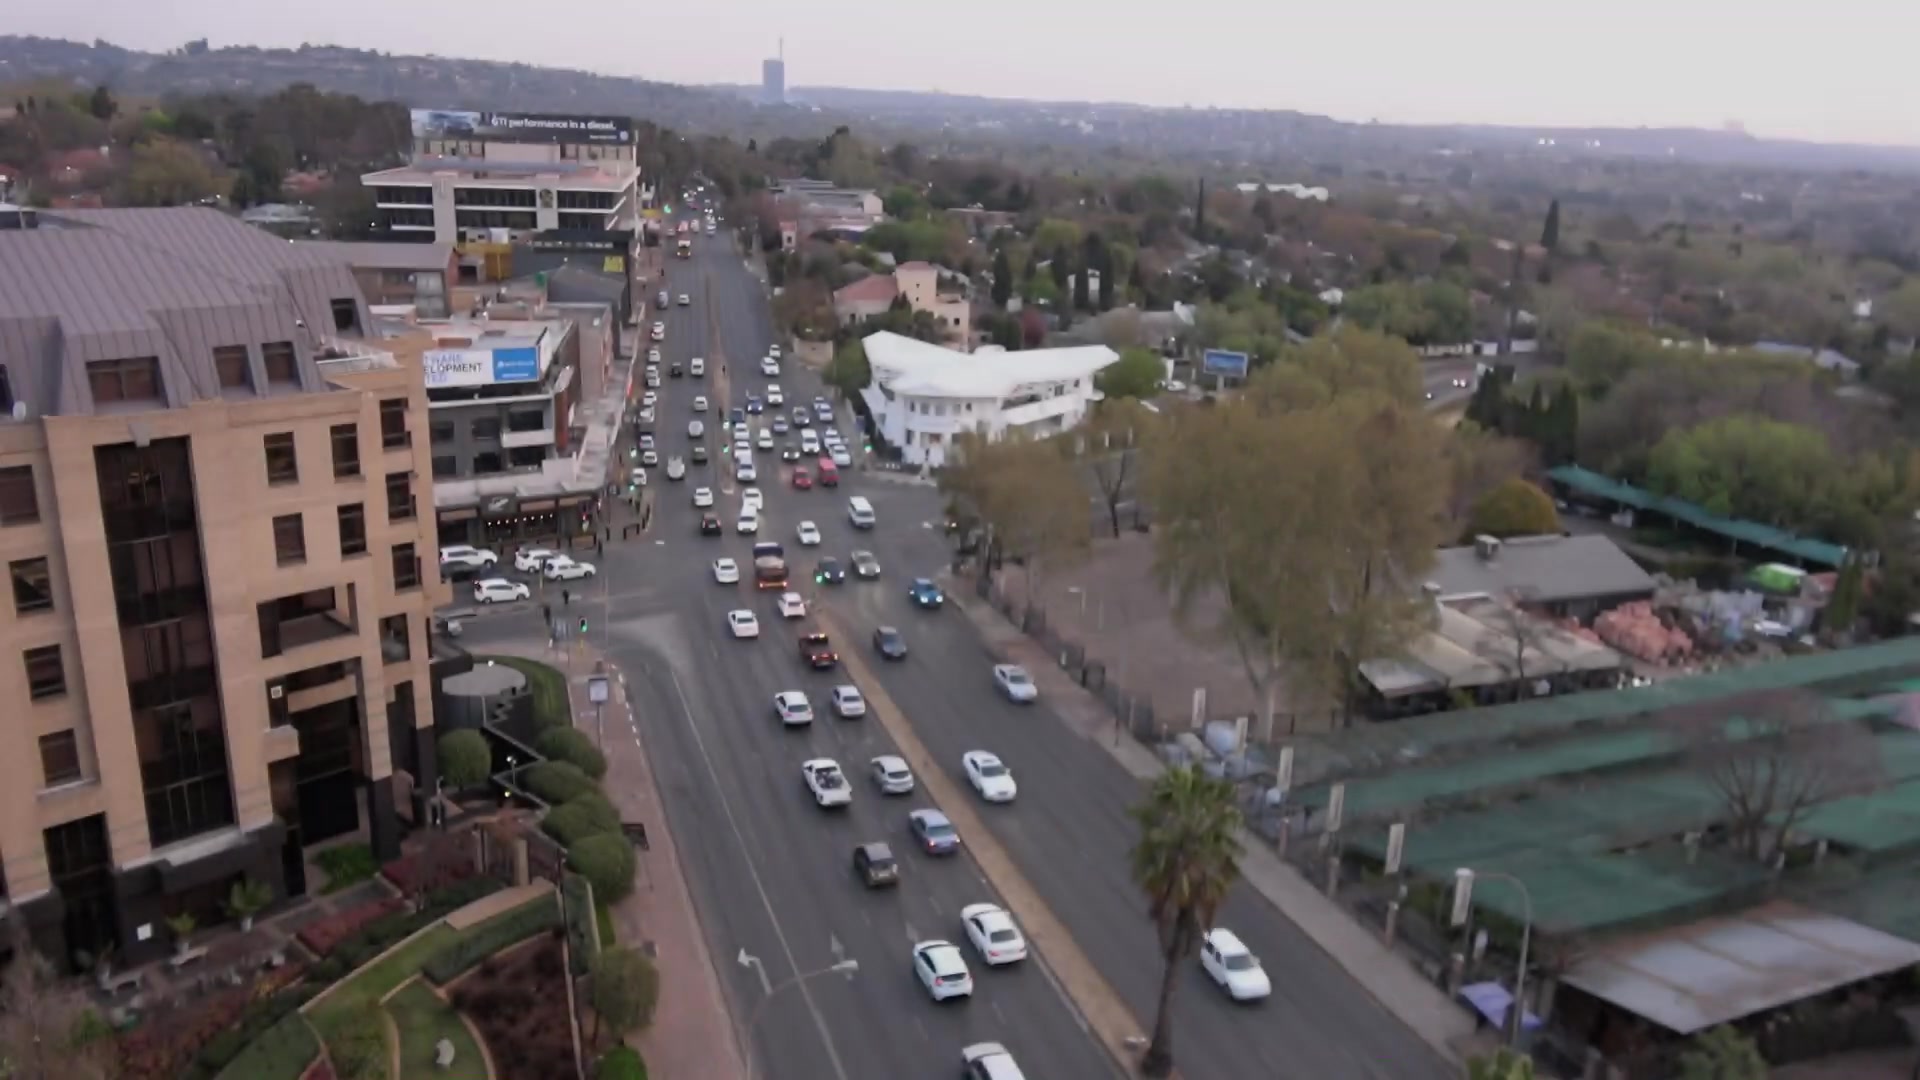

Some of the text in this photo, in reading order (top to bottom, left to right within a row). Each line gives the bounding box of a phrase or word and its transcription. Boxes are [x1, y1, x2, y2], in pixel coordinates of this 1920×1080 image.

[508, 117, 568, 129] performance
[569, 120, 579, 129] in
[579, 121, 586, 129] a
[587, 121, 617, 130] diesel.
